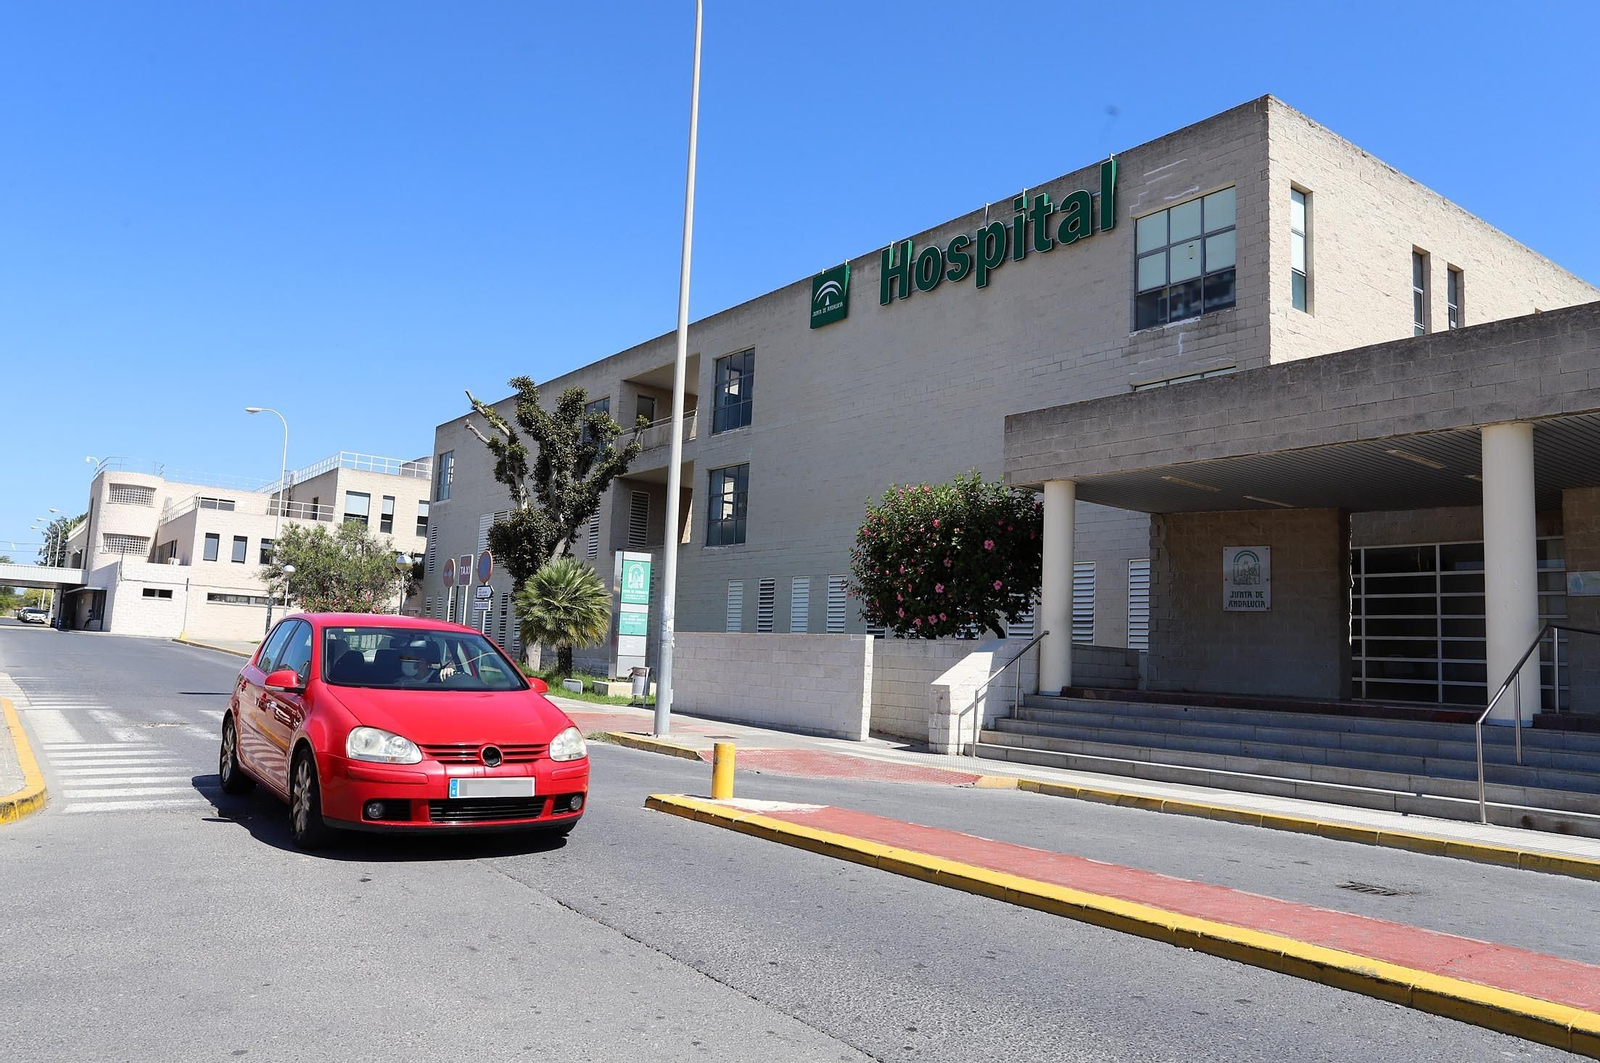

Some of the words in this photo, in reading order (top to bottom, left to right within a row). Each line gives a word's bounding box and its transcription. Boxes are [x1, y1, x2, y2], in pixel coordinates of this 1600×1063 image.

[880, 158, 1117, 306] Hospital
[460, 566, 471, 576] TAXI
[1228, 600, 1266, 608] ANDALUCIA
